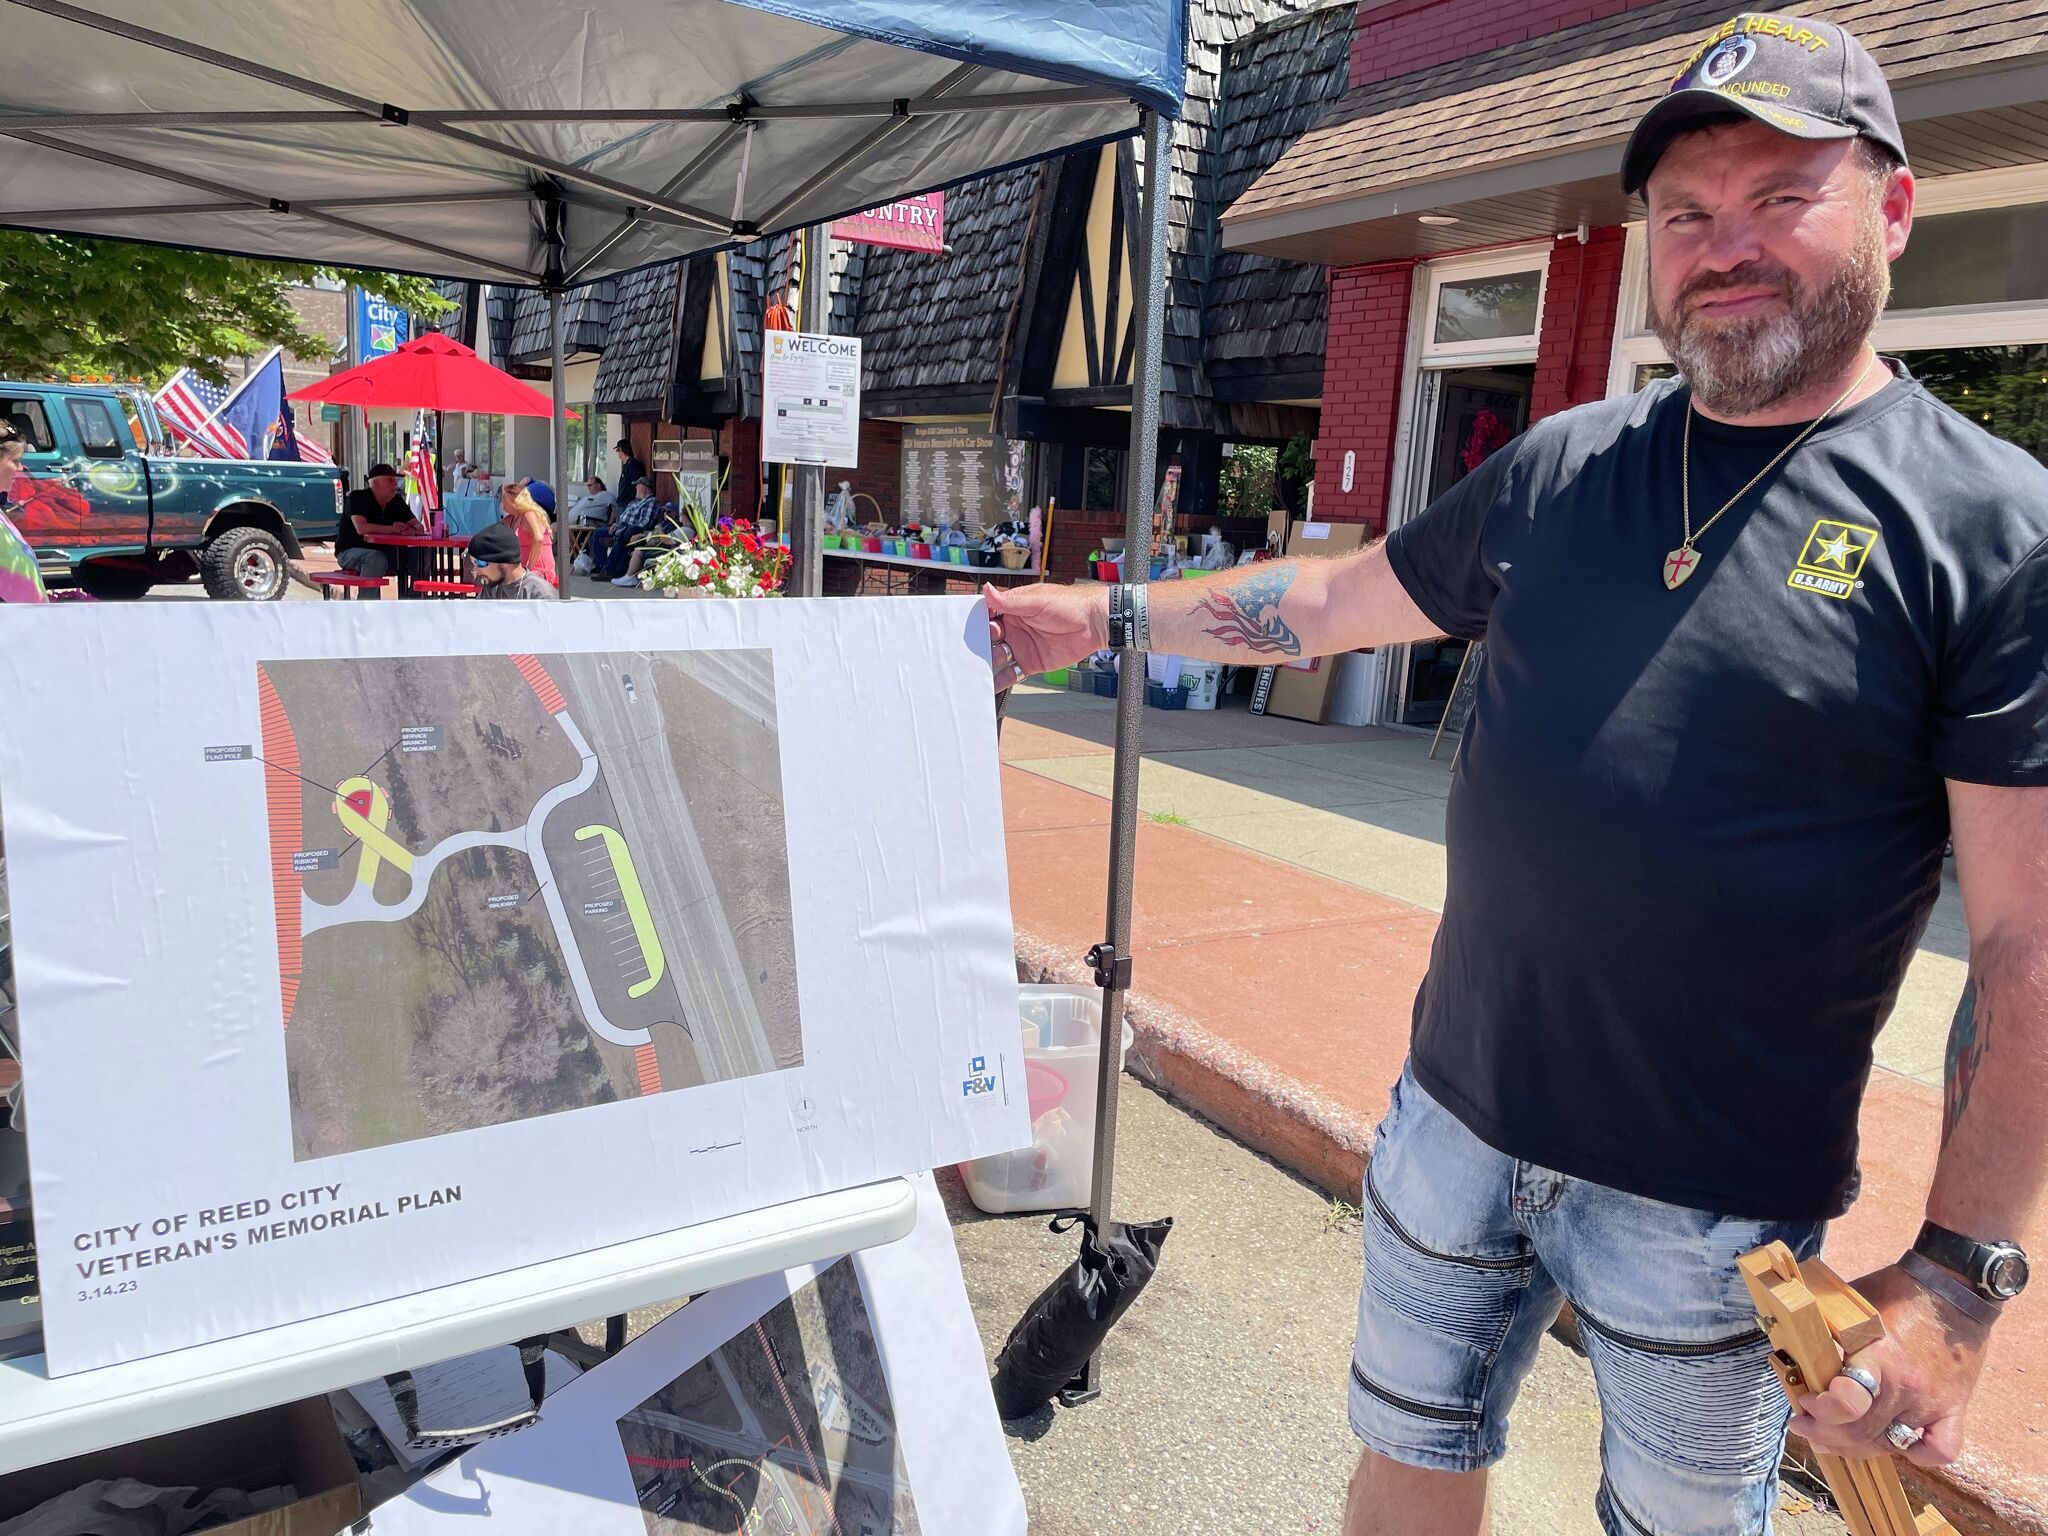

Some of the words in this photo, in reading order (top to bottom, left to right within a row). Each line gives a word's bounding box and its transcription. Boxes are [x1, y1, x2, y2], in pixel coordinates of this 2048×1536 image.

[1744, 15, 1829, 53] HEART
[368, 303, 398, 327] City
[788, 338, 857, 357] WELCOME
[952, 438, 965, 448] Park
[965, 437, 975, 448] Car
[976, 437, 993, 448] Show
[1140, 606, 1148, 622] DAY
[1124, 622, 1133, 640] NEVER
[1141, 623, 1148, 631] A
[1142, 631, 1148, 641] 22
[1253, 665, 1272, 711] ENGINES
[205, 746, 243, 754] PROPOSED
[293, 850, 329, 858] PROPOSED
[294, 857, 319, 865] RIBBON
[487, 894, 519, 902] PROPOSED
[488, 900, 517, 909] WALKWAY
[584, 900, 614, 909] PROPOSED
[584, 907, 609, 915] PARKING
[962, 1075, 996, 1097] F&V
[796, 1124, 818, 1133] NORTH
[73, 1222, 142, 1252] CITY
[151, 1213, 189, 1237] OF
[199, 1197, 271, 1228] REED
[280, 1183, 343, 1212] CITY
[75, 1231, 238, 1281] VETERAN'S
[247, 1200, 389, 1246] MEMORIAL
[397, 1184, 463, 1214] PLAN
[77, 1279, 138, 1303] 3.14.23
